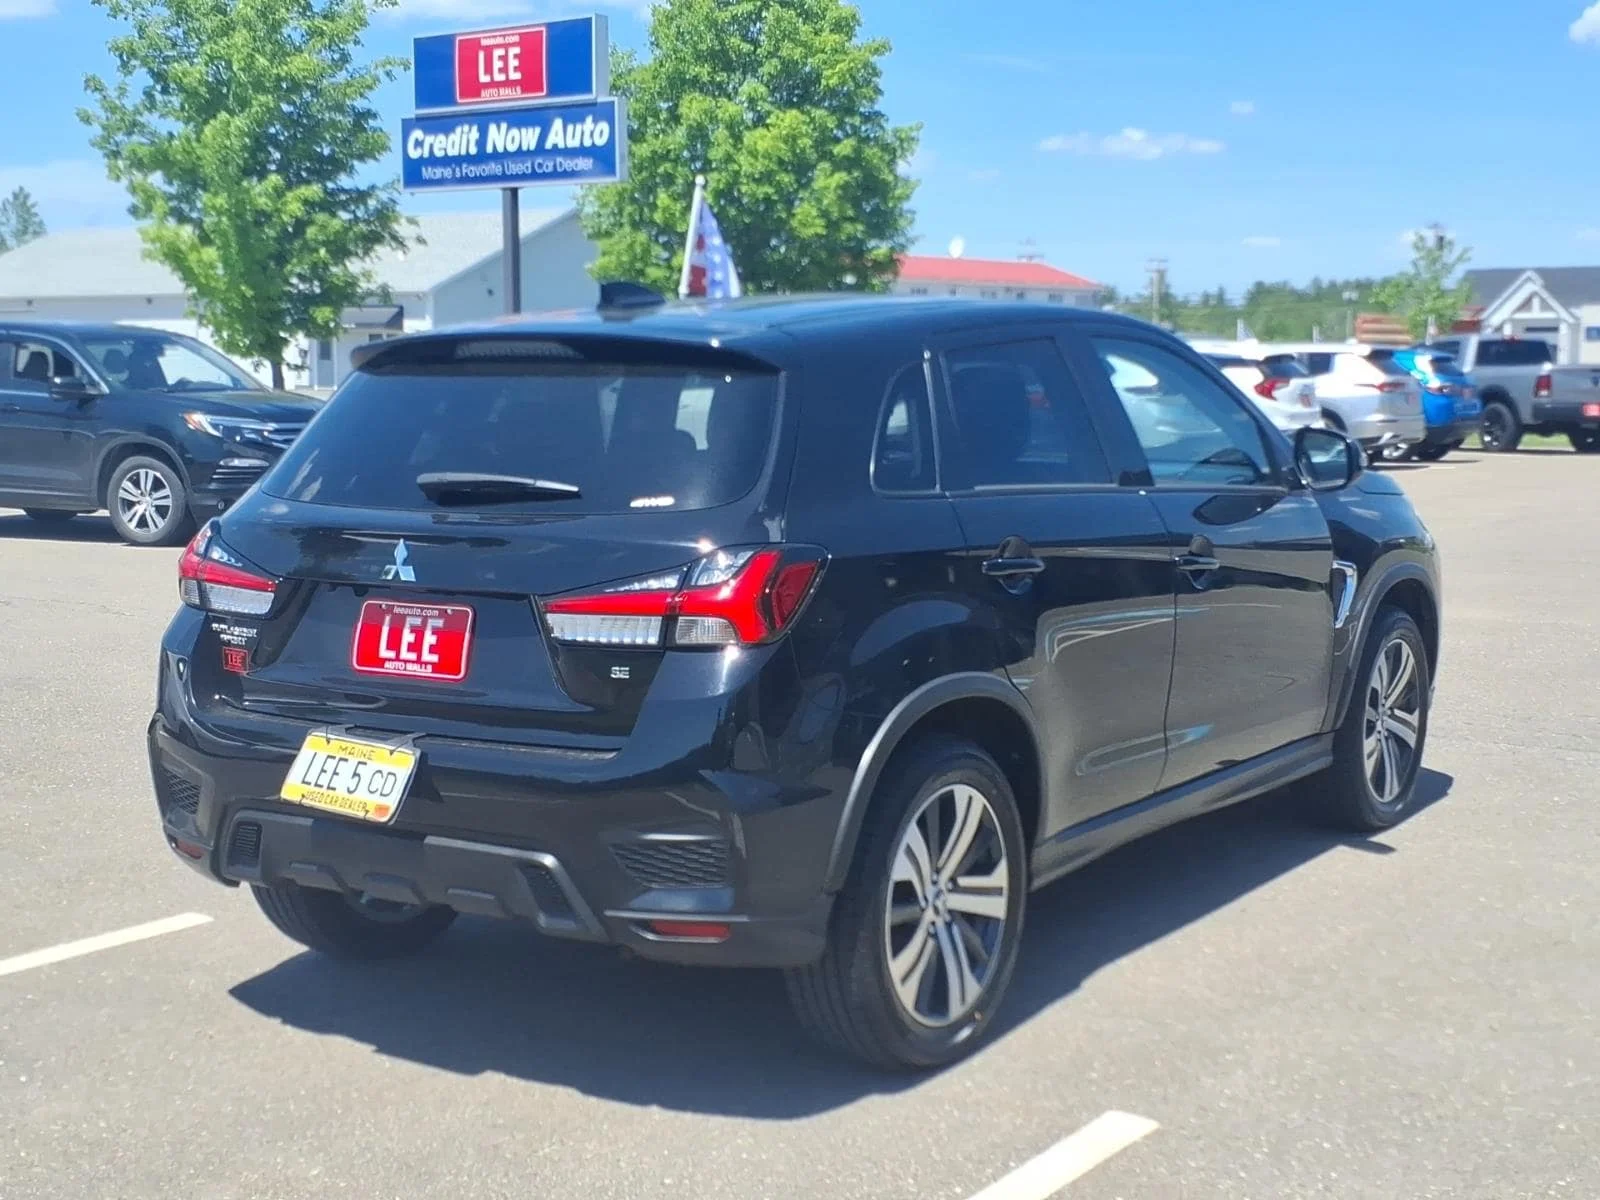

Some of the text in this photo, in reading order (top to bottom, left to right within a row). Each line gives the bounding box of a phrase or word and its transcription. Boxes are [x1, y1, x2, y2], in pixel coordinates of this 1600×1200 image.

[478, 46, 522, 83] LEE
[481, 85, 522, 98] AUTO MALLS
[407, 115, 610, 159] Credit Now Auto
[421, 156, 593, 180] Maine's Favorite Used Car Dealer
[393, 605, 440, 617] leeauto.com
[378, 613, 445, 663] LEE
[228, 653, 243, 667] LEE
[384, 660, 433, 673] AUTO MALLS
[610, 667, 631, 679] SE
[337, 745, 377, 760] MAINE
[301, 752, 398, 797] LEE 5 CD
[305, 790, 369, 812] USED CAR DEALER
